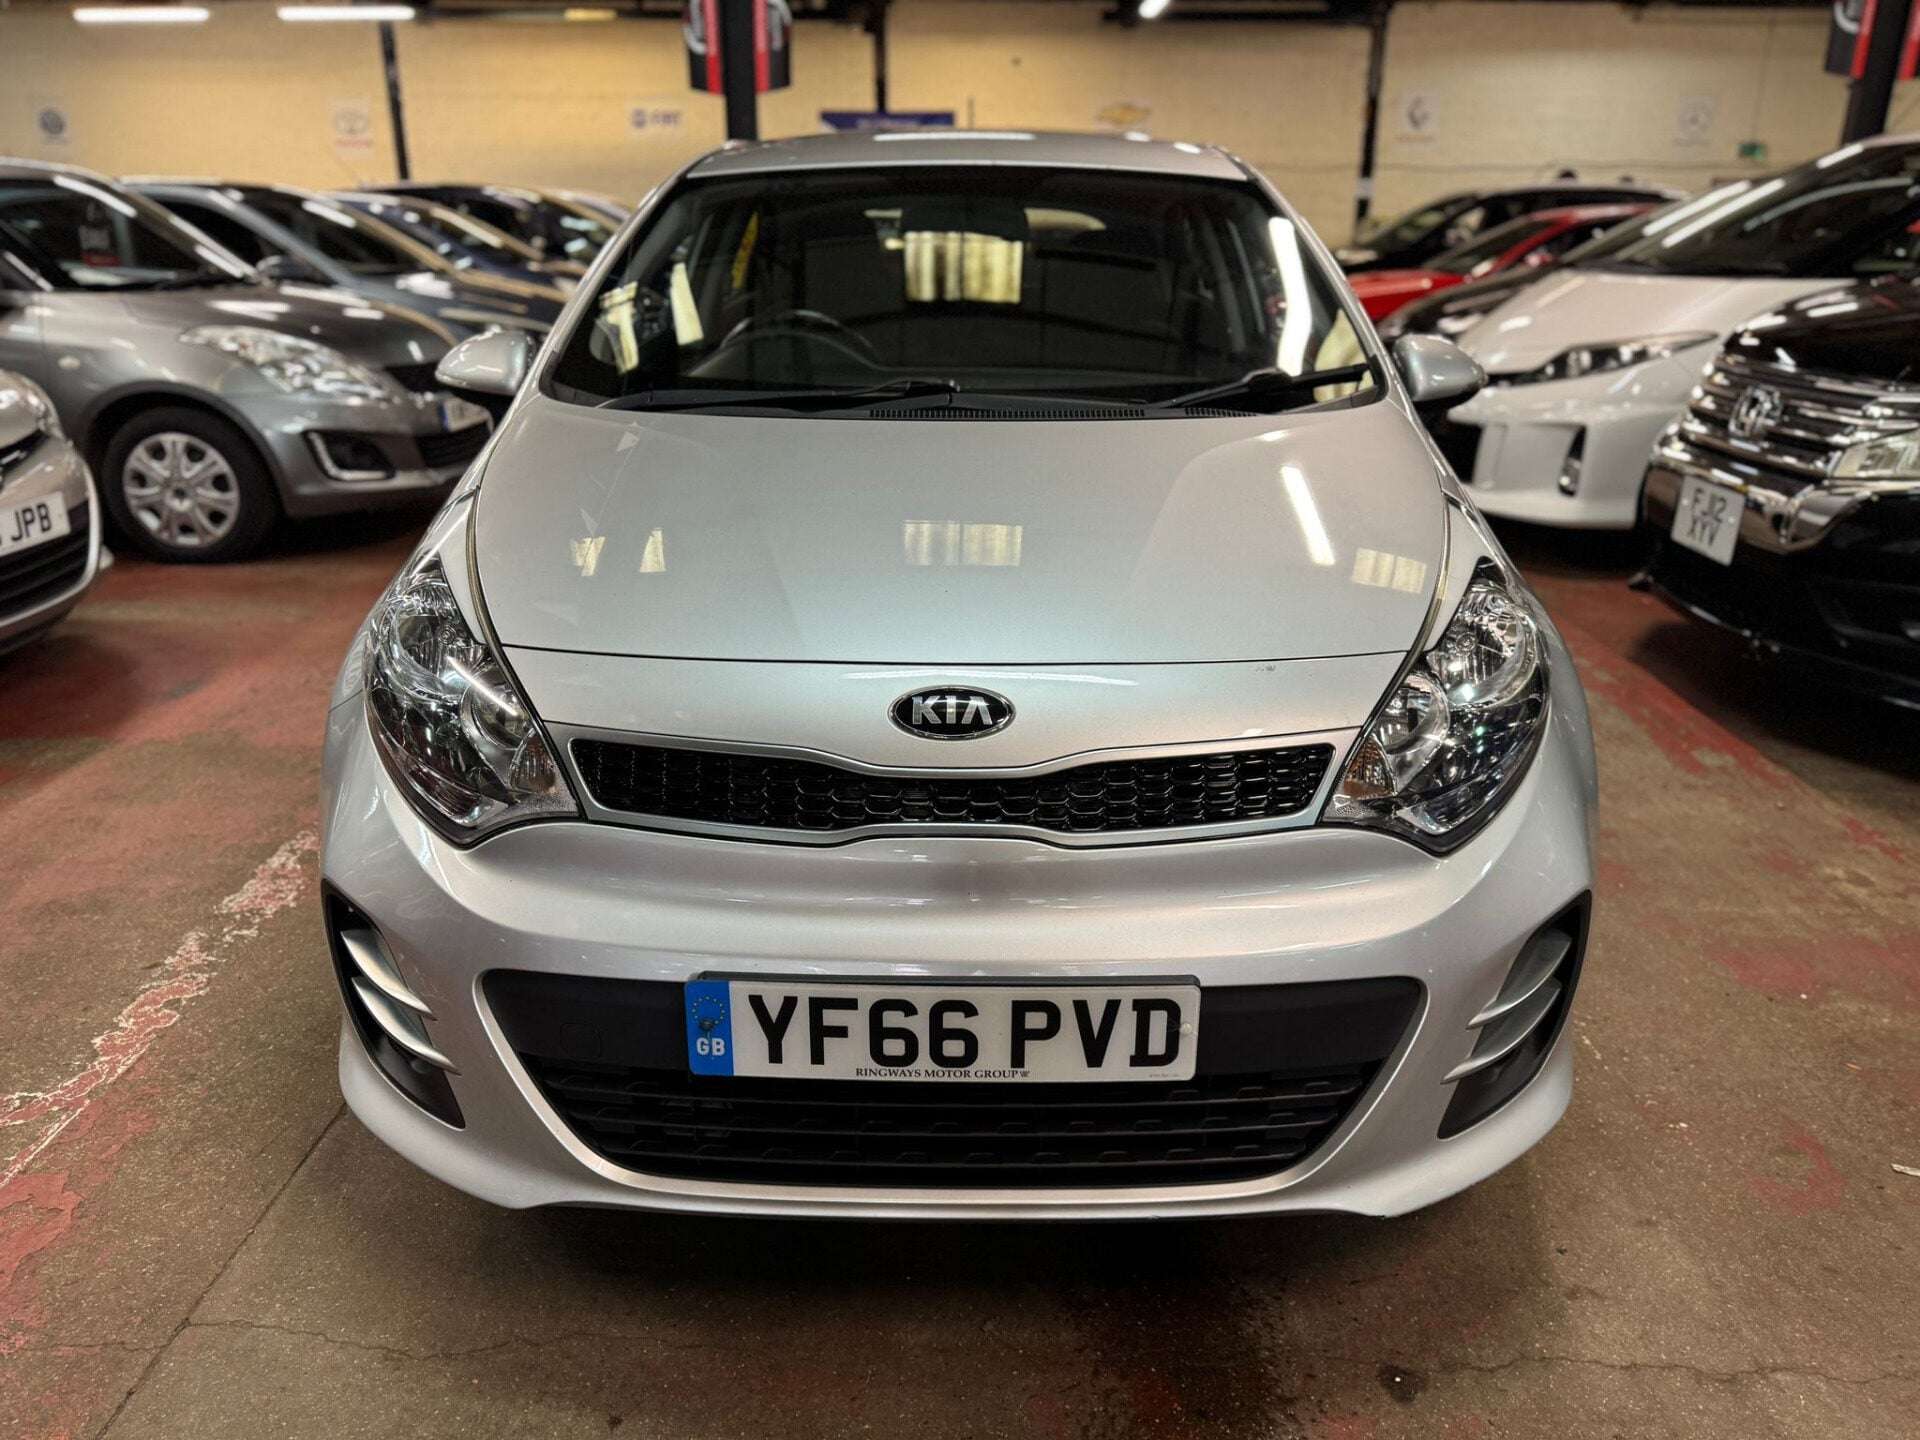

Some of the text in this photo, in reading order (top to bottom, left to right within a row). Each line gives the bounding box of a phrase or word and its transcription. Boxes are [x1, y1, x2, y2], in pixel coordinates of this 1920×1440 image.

[11, 503, 52, 542] JPB
[911, 695, 993, 725] KIA
[696, 1037, 725, 1056] GB
[748, 994, 1181, 1069] YF66 PVD
[855, 1068, 1018, 1079] RINGWAYS MOTOR GROUP
